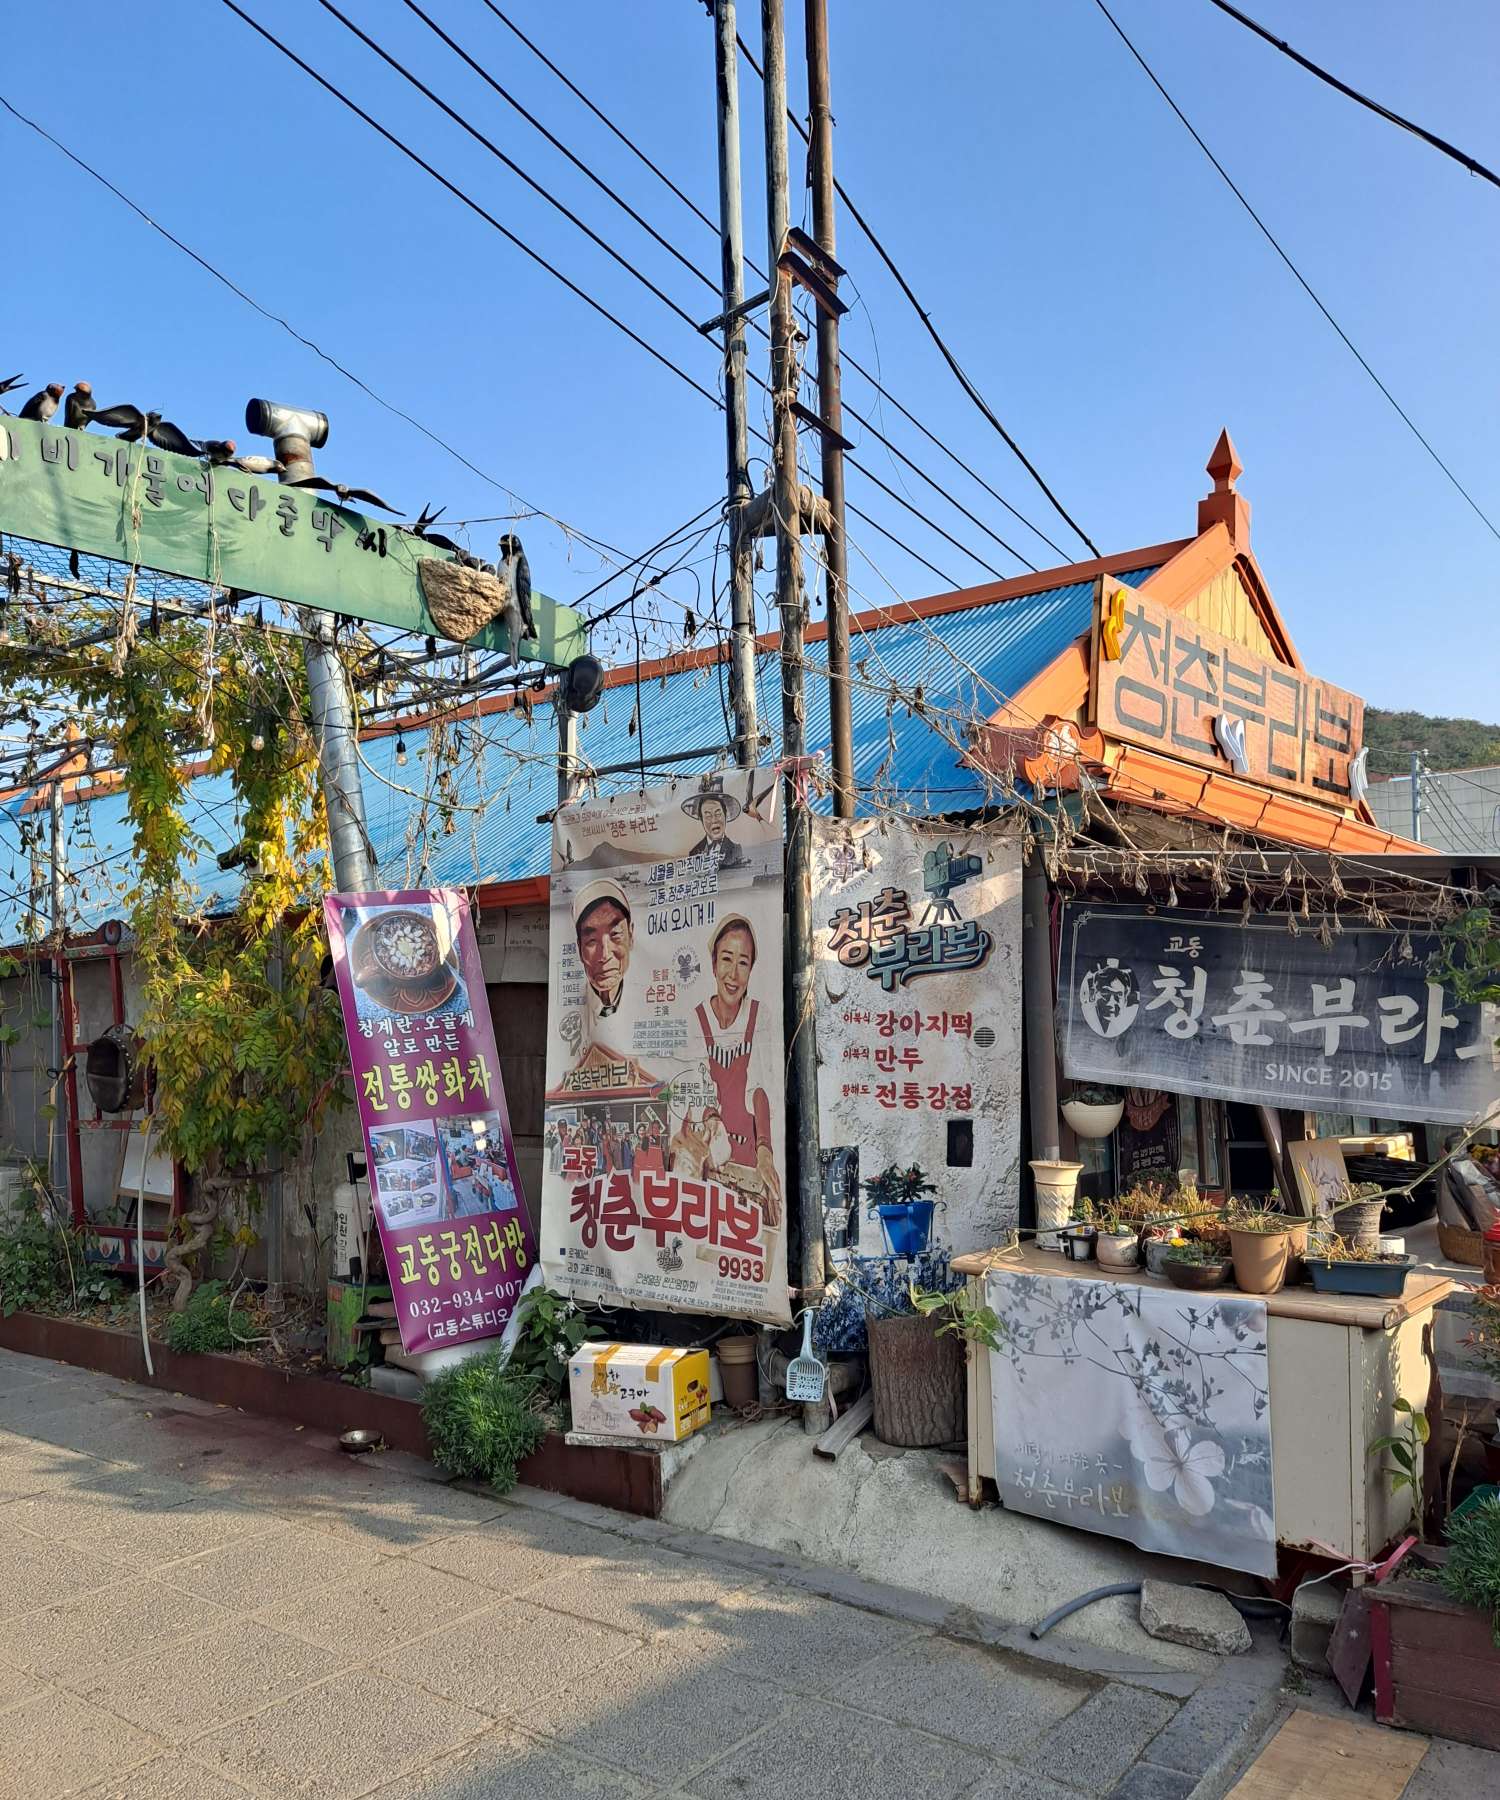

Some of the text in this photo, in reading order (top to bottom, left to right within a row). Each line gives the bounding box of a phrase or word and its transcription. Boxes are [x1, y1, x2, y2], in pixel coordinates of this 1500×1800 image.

[1114, 604, 1353, 797] 청춘부라보
[647, 910, 668, 936] 어서
[827, 887, 912, 968] 청춘
[867, 919, 993, 991] 부라보
[1163, 935, 1205, 959] 교동
[645, 983, 676, 1004] 손윤경
[842, 1010, 973, 1040] 이북식 강아지떡
[383, 1033, 461, 1058] 알로 만든
[842, 1044, 924, 1073] 이북식 만두
[361, 1053, 492, 1112] 전통쌍화차
[569, 1061, 628, 1091] 청춘부라보
[1264, 1062, 1393, 1092] SINCE 2015
[841, 1081, 973, 1111] 황해도 전통강정
[562, 1147, 598, 1179] 교동
[569, 1172, 763, 1257] 청춘부라보
[395, 1216, 528, 1287] 교동궁전다방
[718, 1254, 765, 1284] 9933
[408, 1279, 525, 1319] 032-934-007
[619, 1386, 650, 1401] 고구마
[1013, 1466, 1130, 1519] 청춘부라보
